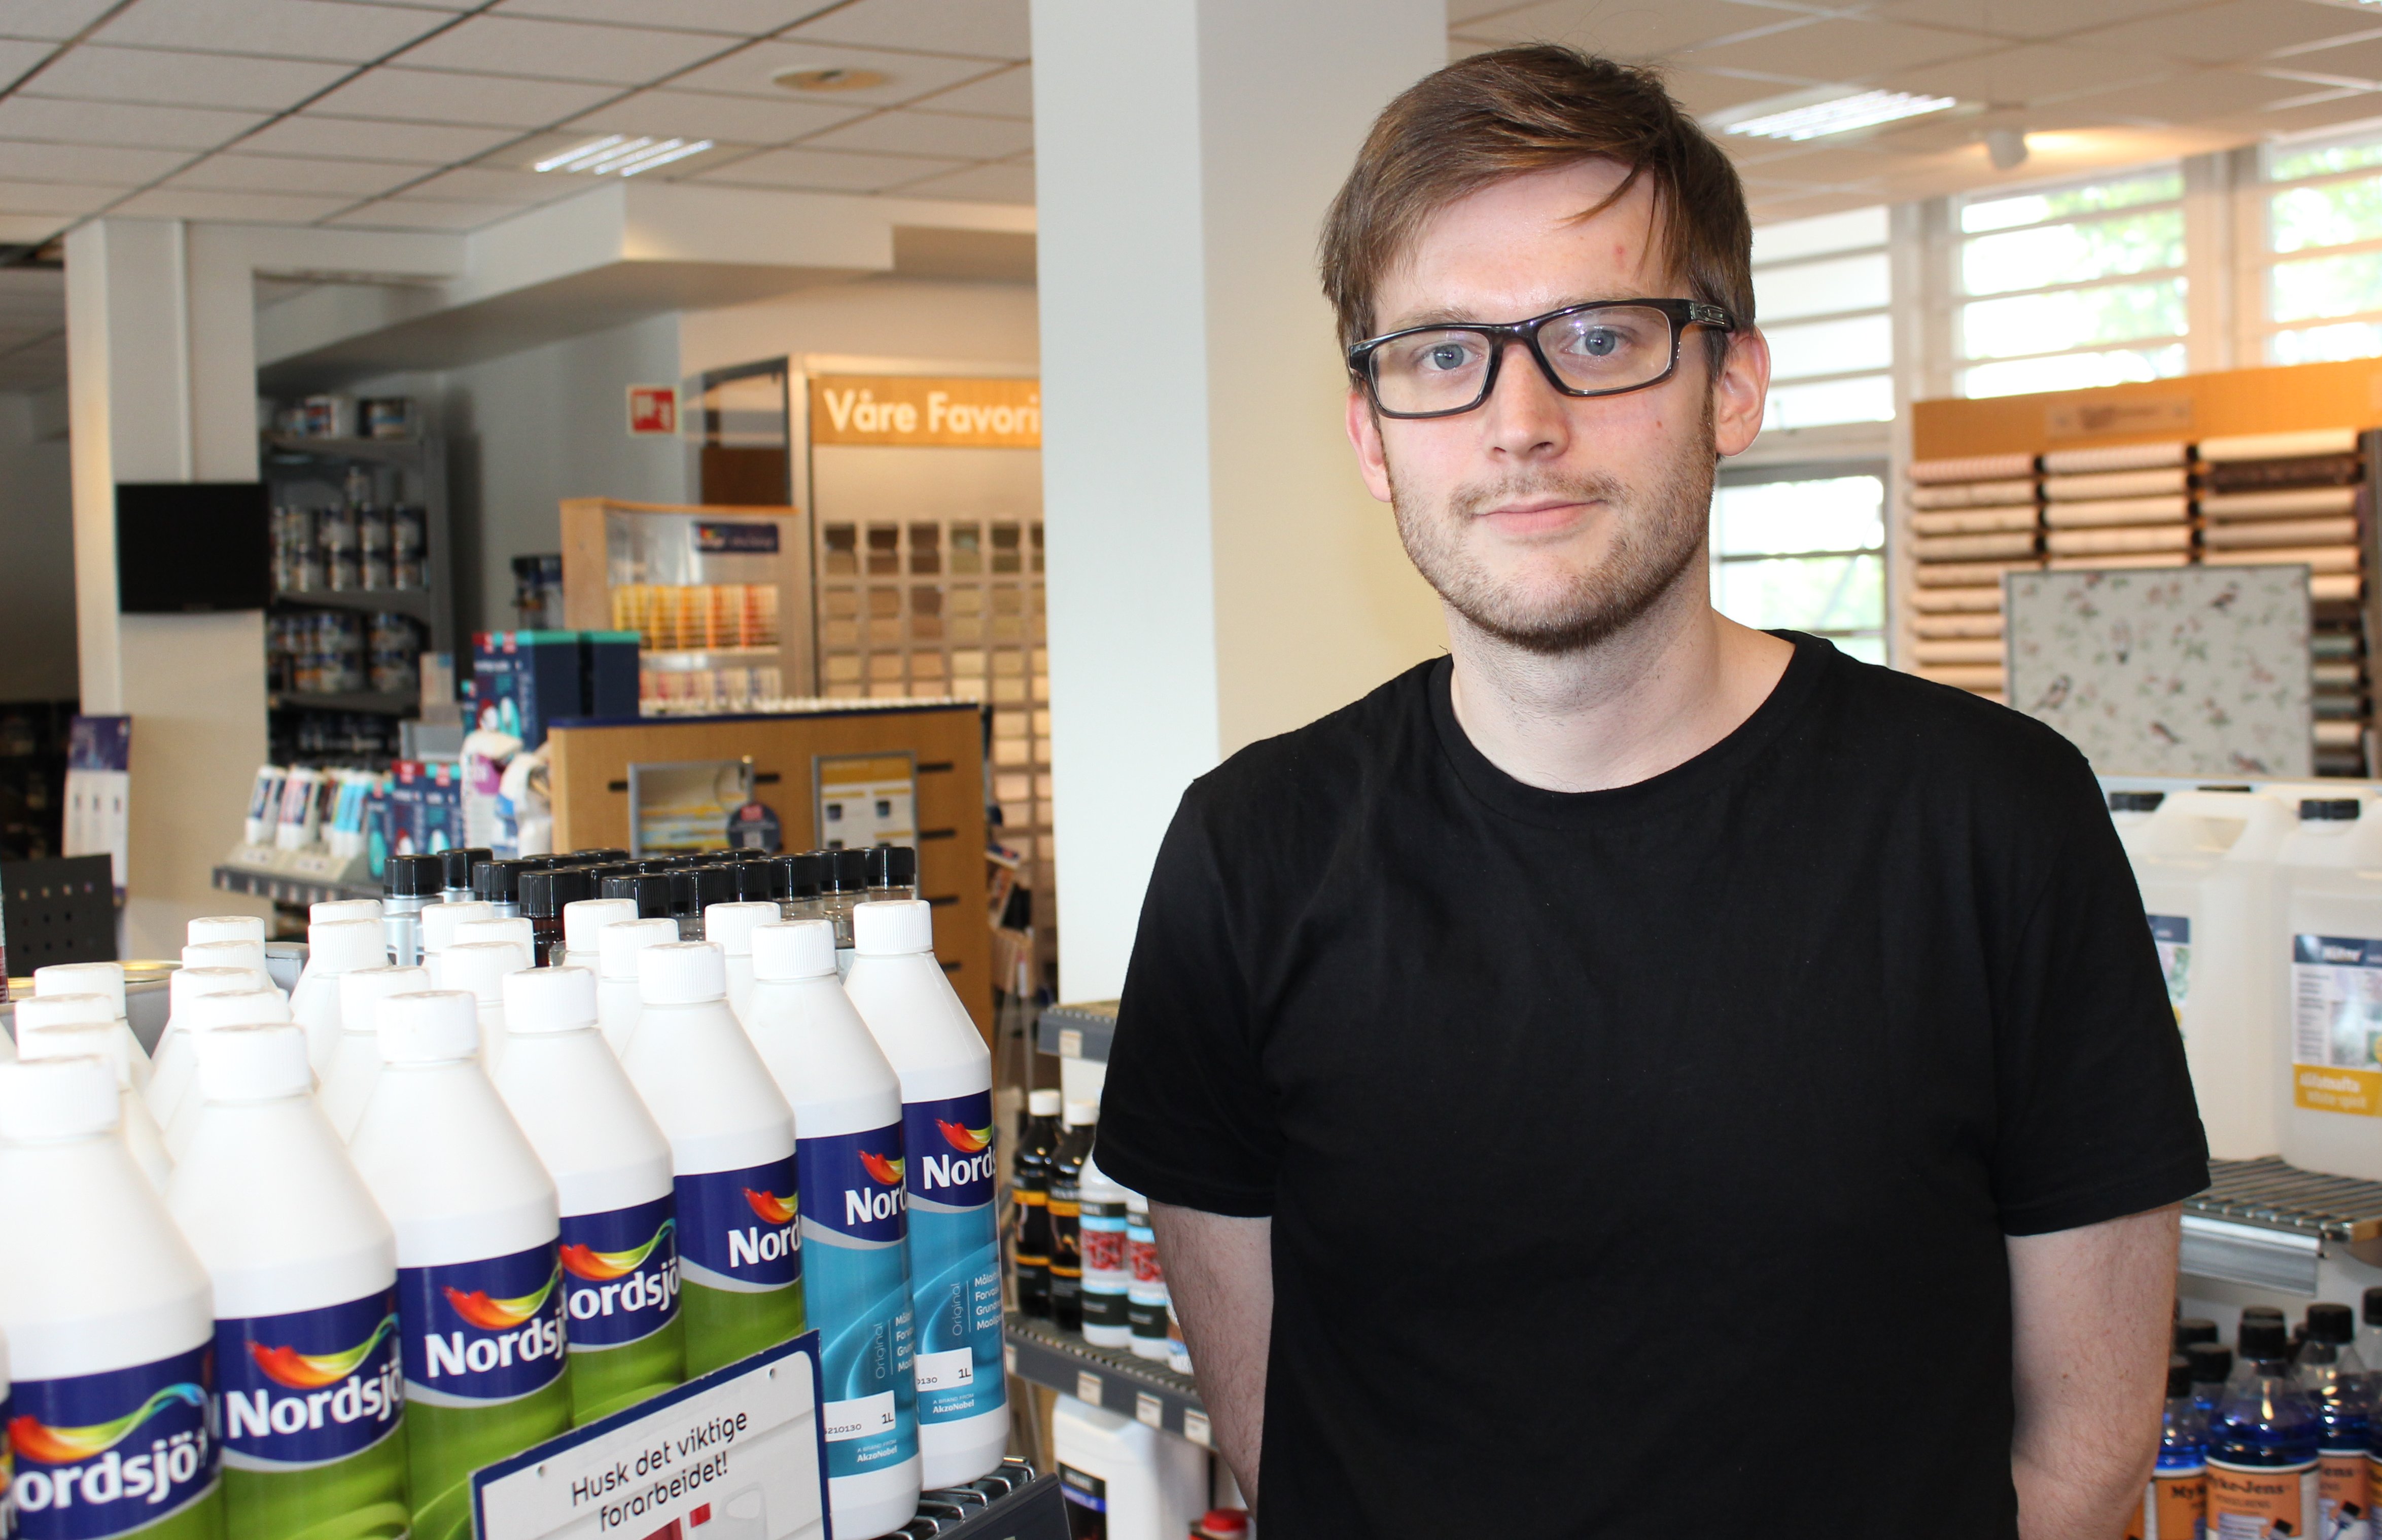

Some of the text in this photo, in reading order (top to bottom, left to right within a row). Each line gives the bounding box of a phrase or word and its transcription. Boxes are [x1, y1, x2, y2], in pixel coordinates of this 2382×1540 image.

[823, 388, 1039, 435] Våre Favori
[727, 1214, 801, 1268] Nord
[563, 1257, 681, 1320] ordsjö
[950, 1281, 964, 1336] Original
[425, 1307, 567, 1378] Nordsj
[873, 1321, 887, 1379] Original
[958, 1368, 971, 1379] 1L
[881, 1412, 894, 1424] 1L
[933, 1399, 974, 1414] AkzoNobel
[13, 1430, 199, 1513] ordsjö
[571, 1411, 748, 1507] Husk det viktige
[857, 1445, 897, 1463] AkzoNobel
[600, 1450, 728, 1532] forarbeidet!
